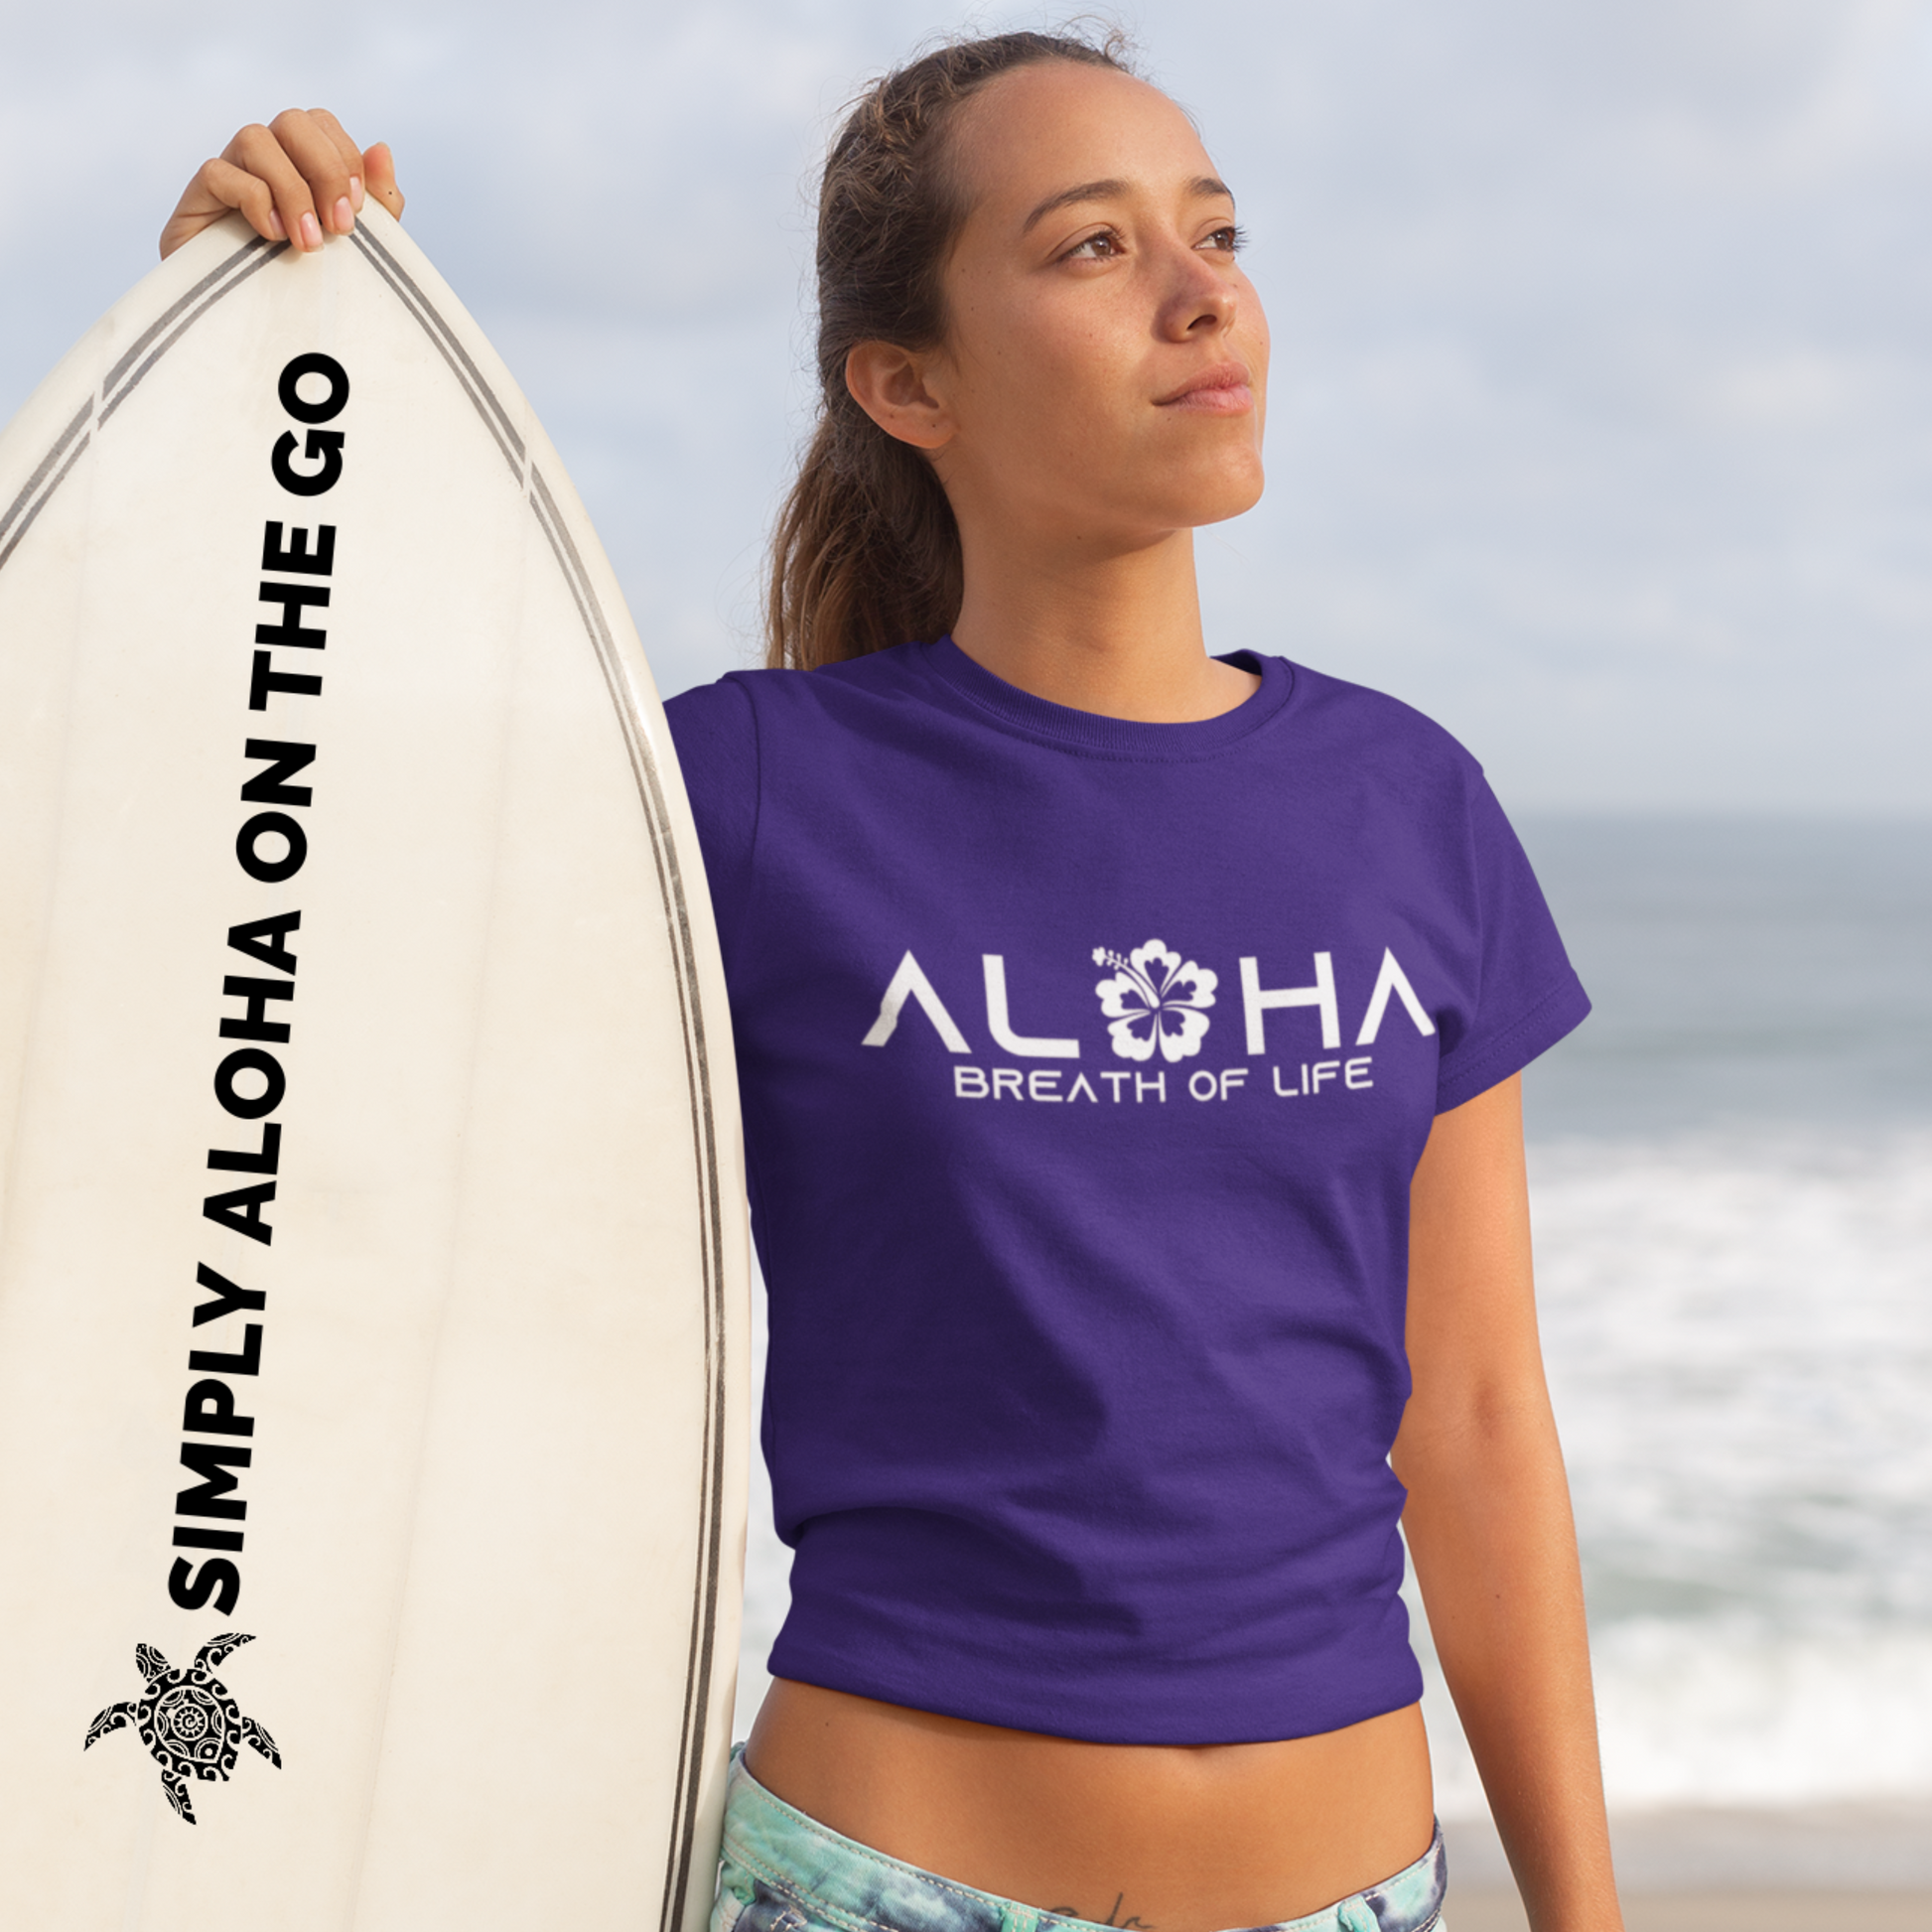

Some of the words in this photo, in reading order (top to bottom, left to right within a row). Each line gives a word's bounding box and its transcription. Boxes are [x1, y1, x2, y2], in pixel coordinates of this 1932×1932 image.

[271, 352, 349, 496] GO
[248, 520, 337, 712] THE
[235, 738, 317, 884] ON
[203, 909, 302, 1247] ALOHA
[954, 1065, 1167, 1103] BREATH
[1188, 1068, 1249, 1101] OF
[1273, 1056, 1374, 1097] LIFE
[168, 1262, 267, 1616] SIMPLY
